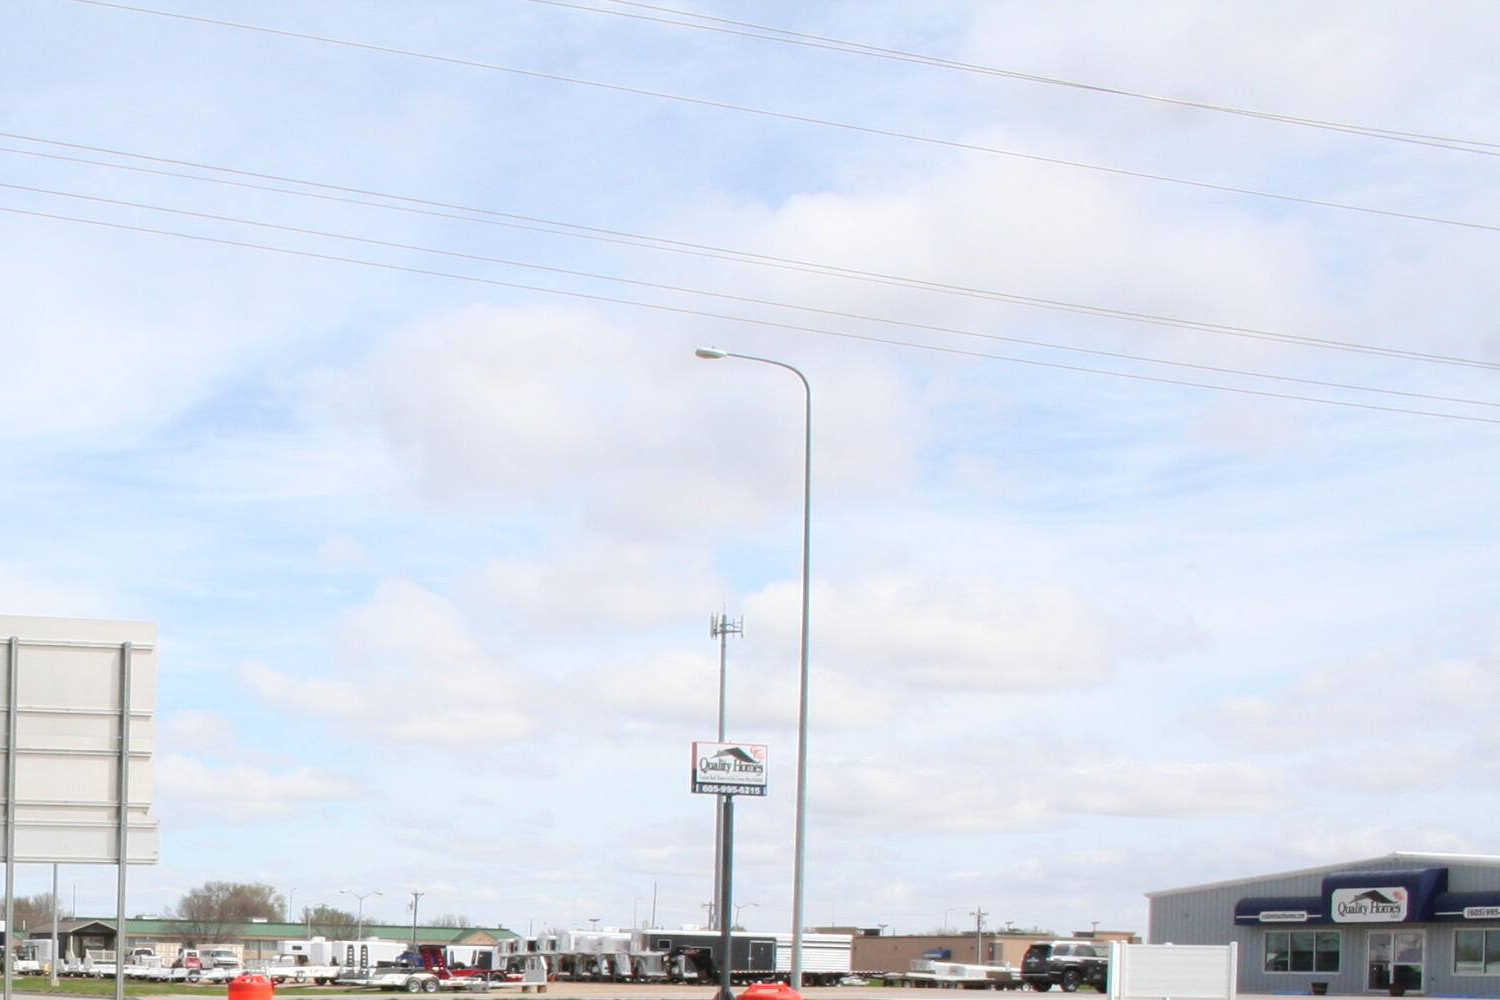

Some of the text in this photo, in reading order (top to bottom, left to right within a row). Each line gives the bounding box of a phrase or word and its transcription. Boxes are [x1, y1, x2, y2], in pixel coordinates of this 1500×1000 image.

[699, 757, 763, 776] Quality Homes
[702, 784, 761, 794] 605-995-6215
[1337, 901, 1401, 917] Quality Homes
